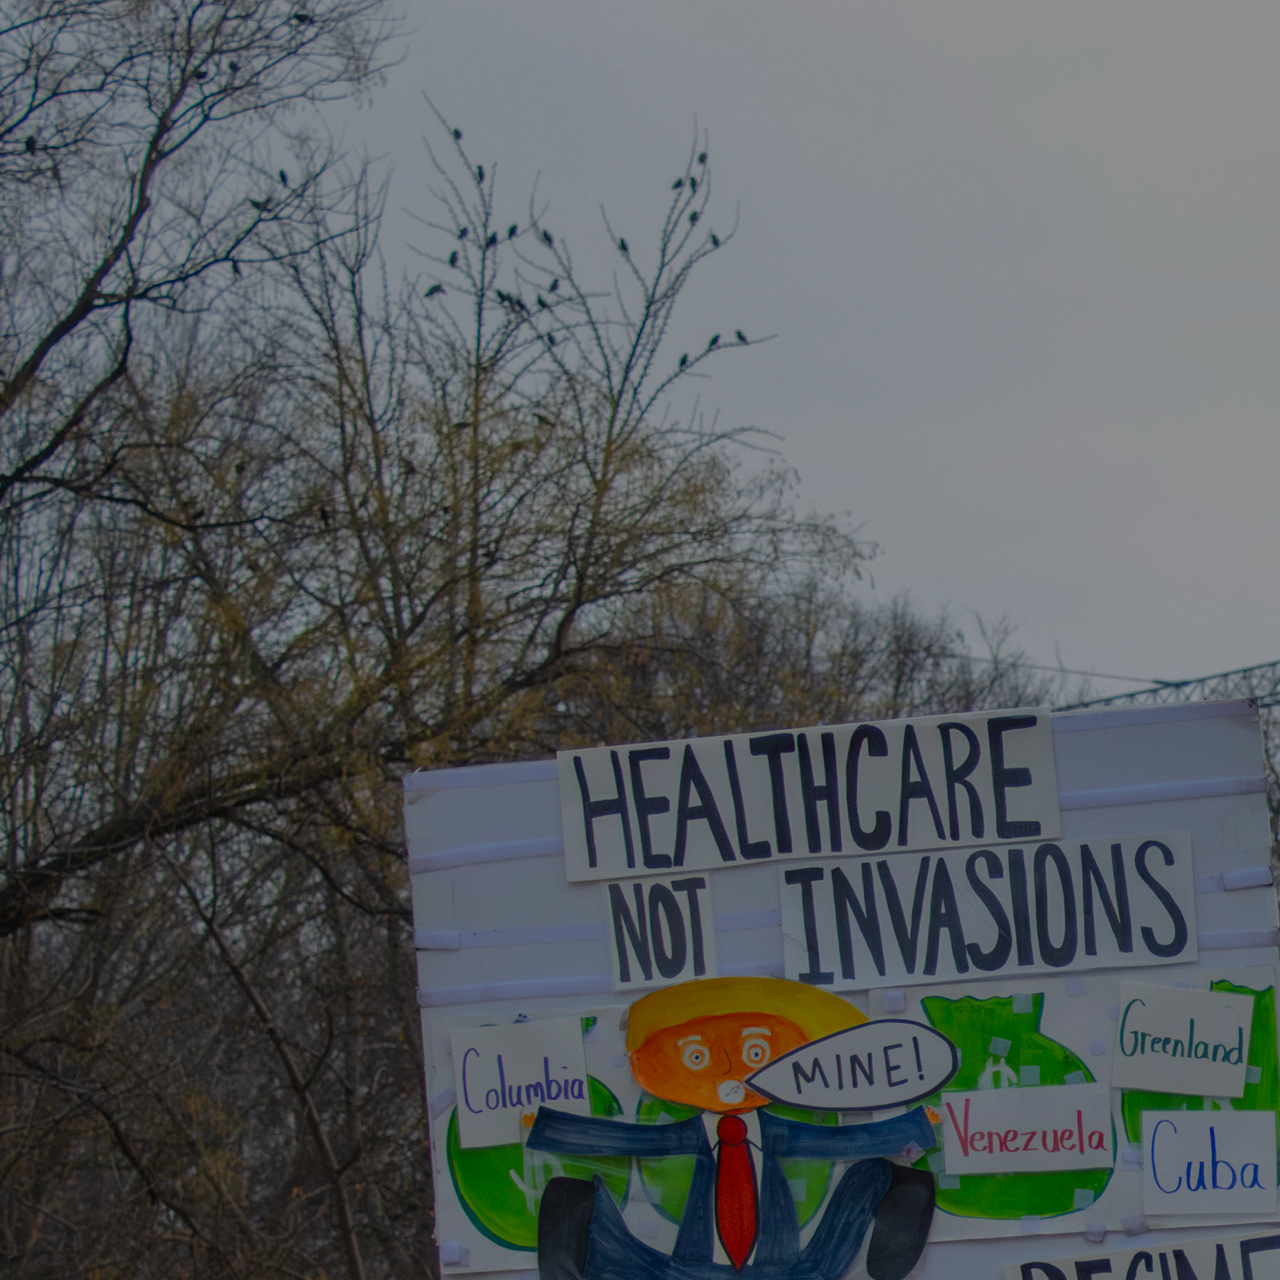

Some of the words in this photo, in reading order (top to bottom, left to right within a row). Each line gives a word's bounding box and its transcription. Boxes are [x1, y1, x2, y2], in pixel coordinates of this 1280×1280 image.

[572, 715, 1042, 869] HEALTHCARE
[610, 877, 706, 984] NOT
[785, 840, 1188, 986] INVASIONS
[792, 1037, 928, 1091] MINE!
[1119, 998, 1245, 1066] Greenland
[463, 1047, 586, 1114] Columbia
[946, 1098, 1108, 1157] Venezuela
[1151, 1119, 1266, 1194] Cuba
